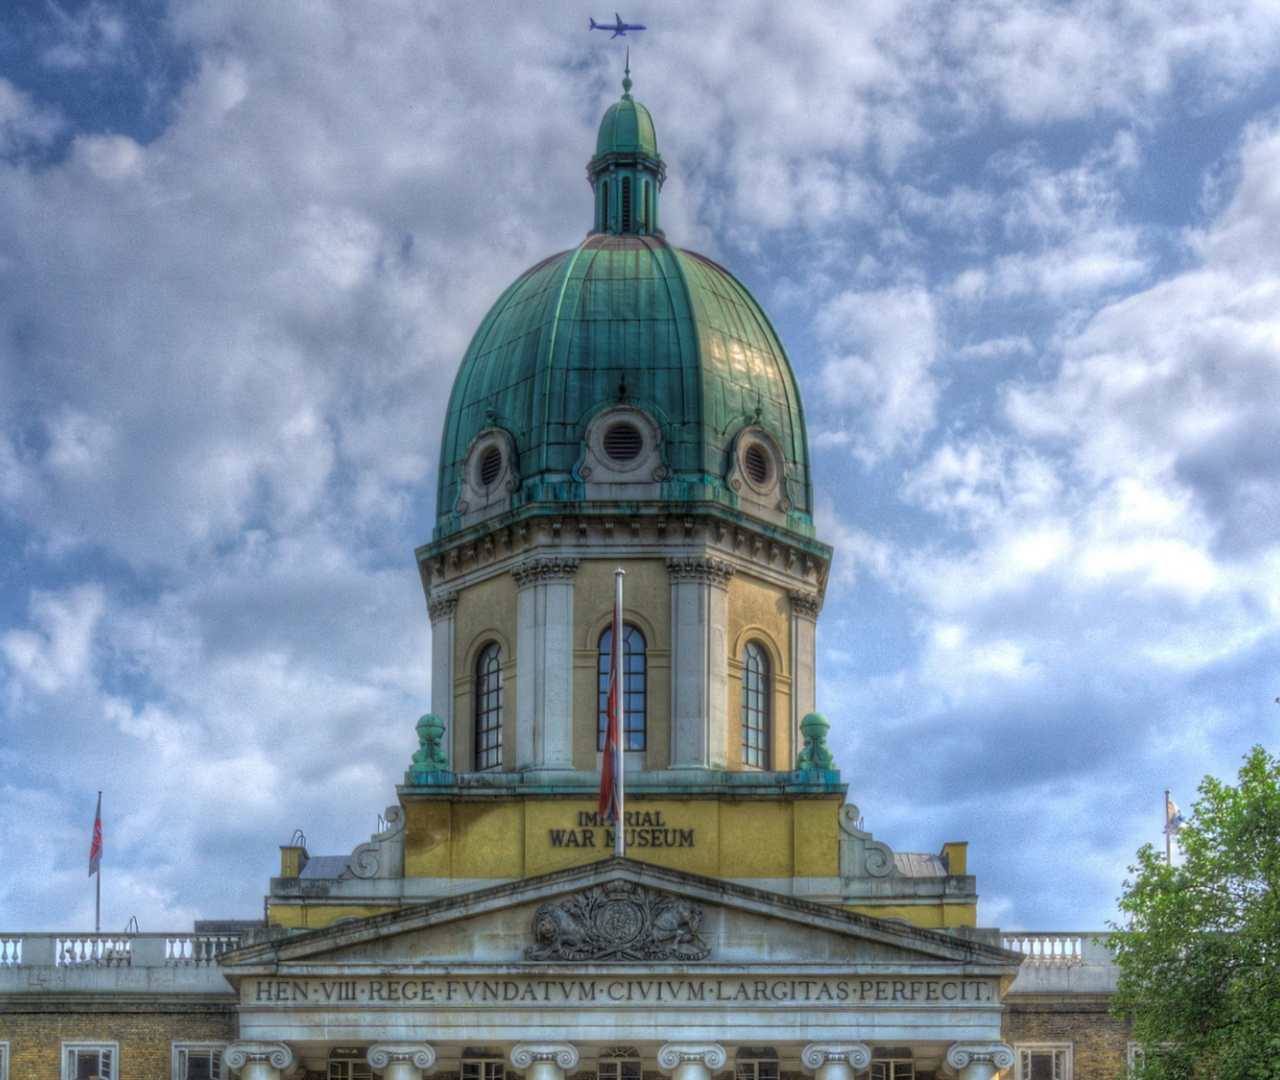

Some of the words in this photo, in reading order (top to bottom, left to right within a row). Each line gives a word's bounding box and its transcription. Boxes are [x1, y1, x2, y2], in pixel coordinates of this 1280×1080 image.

[578, 811, 666, 827] IMRIAL
[549, 829, 596, 848] WAR
[605, 829, 695, 848] MUSEUM
[256, 981, 309, 1001] HEN
[321, 981, 358, 1001] VIII
[369, 981, 436, 1001] REGE
[446, 981, 597, 1001] FVNDATVM
[607, 981, 706, 1001] CIVIVM
[716, 981, 850, 1001] LARGITAS
